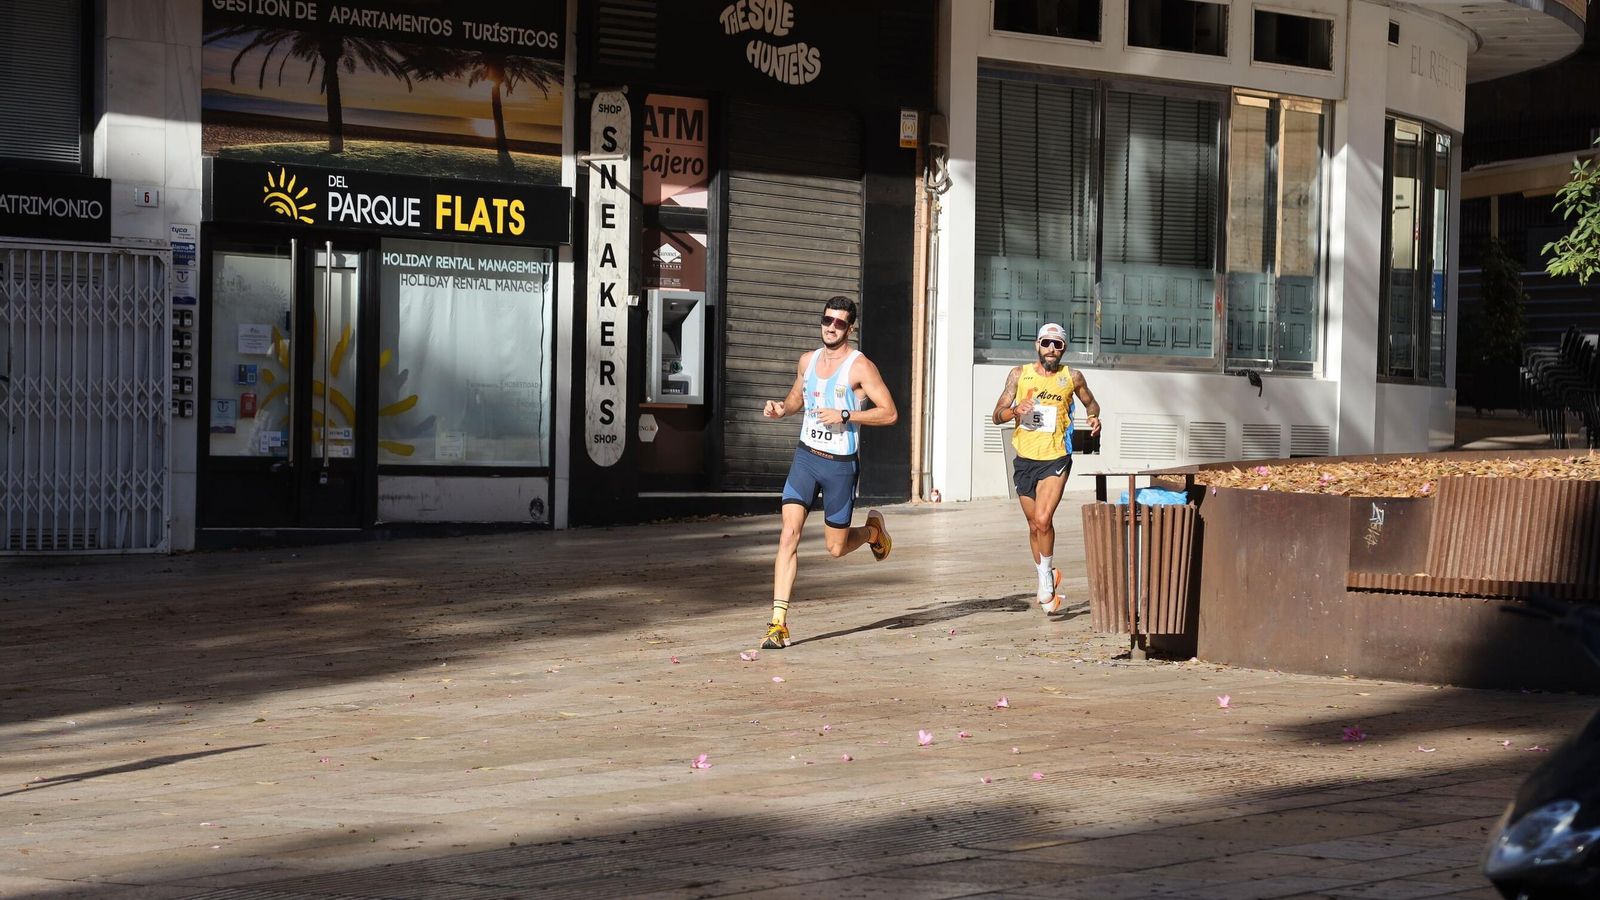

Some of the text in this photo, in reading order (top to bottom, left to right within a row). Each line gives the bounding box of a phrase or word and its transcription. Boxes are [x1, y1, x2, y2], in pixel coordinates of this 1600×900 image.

[295, 1, 317, 21] DE
[328, 5, 453, 36] APARTAMENTOS
[462, 21, 558, 49] TURÍSTICOS
[719, 0, 795, 36] THE SOLE
[746, 40, 822, 85] HUNTERS
[1411, 45, 1424, 77] EL
[598, 103, 622, 114] SHOP
[643, 104, 704, 141] ATM
[328, 175, 348, 188] DEL
[328, 192, 526, 236] PARQUE FLATS
[382, 252, 550, 275] HOLIDAY RENTAL MANAGEMENT
[599, 126, 618, 425] SNEAKERS
[401, 273, 450, 289] HOLIDAY
[452, 276, 492, 291] RENTAL
[1033, 414, 1041, 423] 5
[593, 434, 617, 444] SHOP
[811, 429, 833, 441] 870
